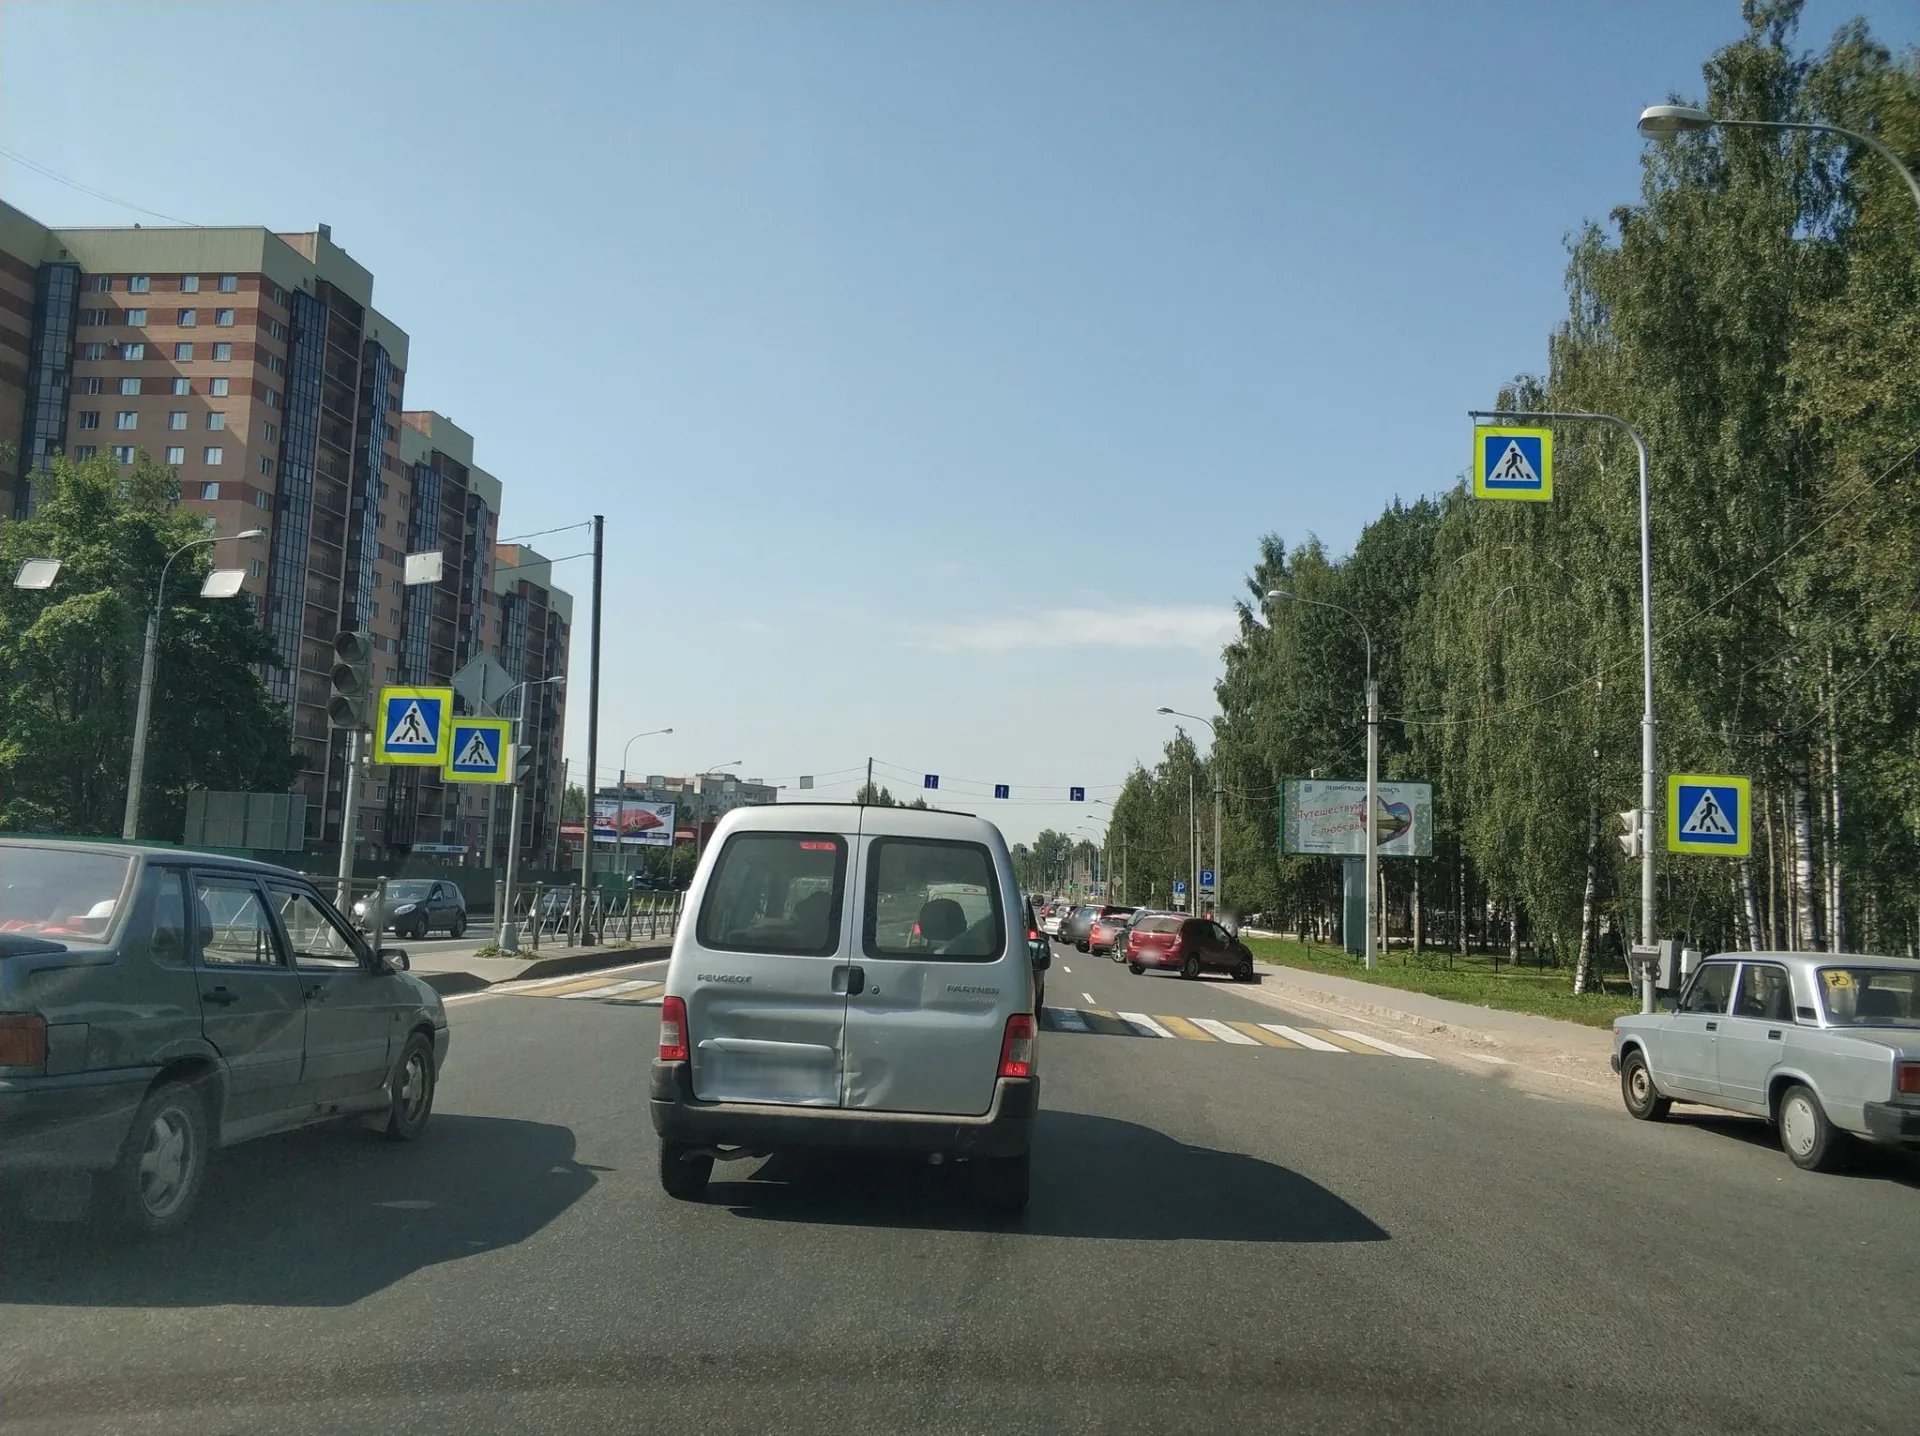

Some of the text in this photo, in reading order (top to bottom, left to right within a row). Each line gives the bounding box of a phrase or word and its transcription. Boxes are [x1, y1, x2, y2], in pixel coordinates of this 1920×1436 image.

[1203, 872, 1212, 884] P
[1177, 883, 1184, 892] P
[697, 973, 752, 984] PEUGEOT
[946, 985, 999, 995] PARTNER
